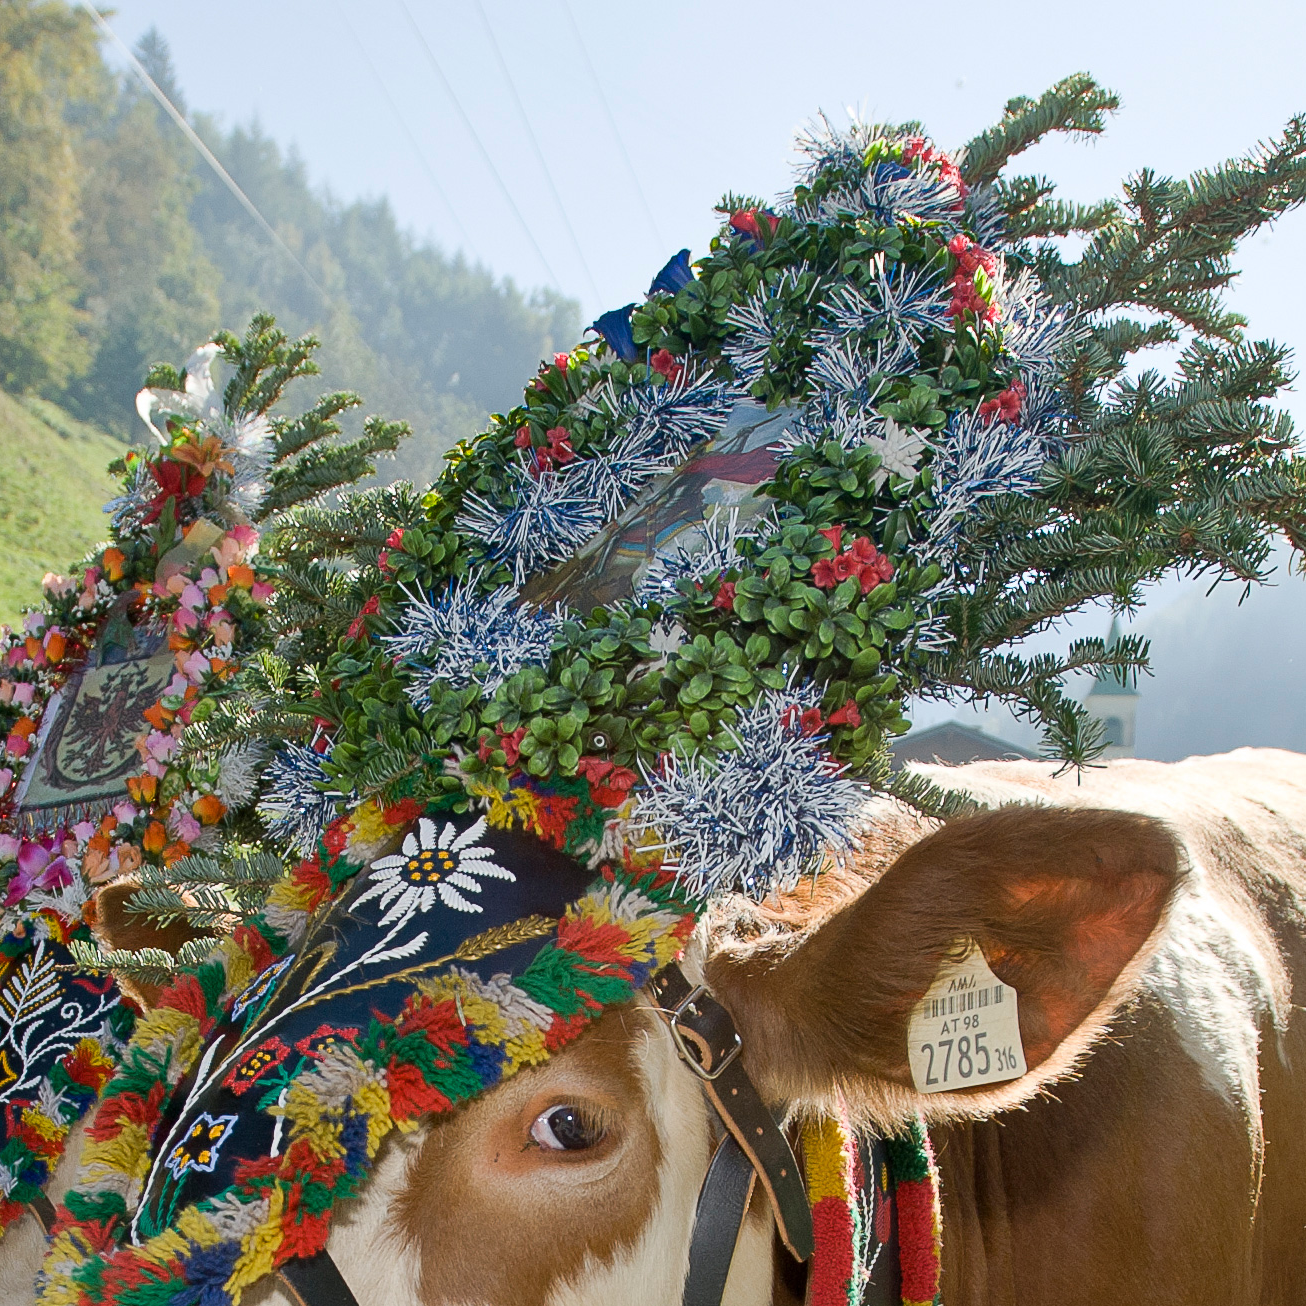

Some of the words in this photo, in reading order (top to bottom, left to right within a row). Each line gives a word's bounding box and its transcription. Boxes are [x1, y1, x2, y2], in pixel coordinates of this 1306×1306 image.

[940, 1017, 960, 1036] AT
[963, 1014, 980, 1031] 98
[921, 1032, 991, 1086] 2785
[995, 1046, 1017, 1072] 316
